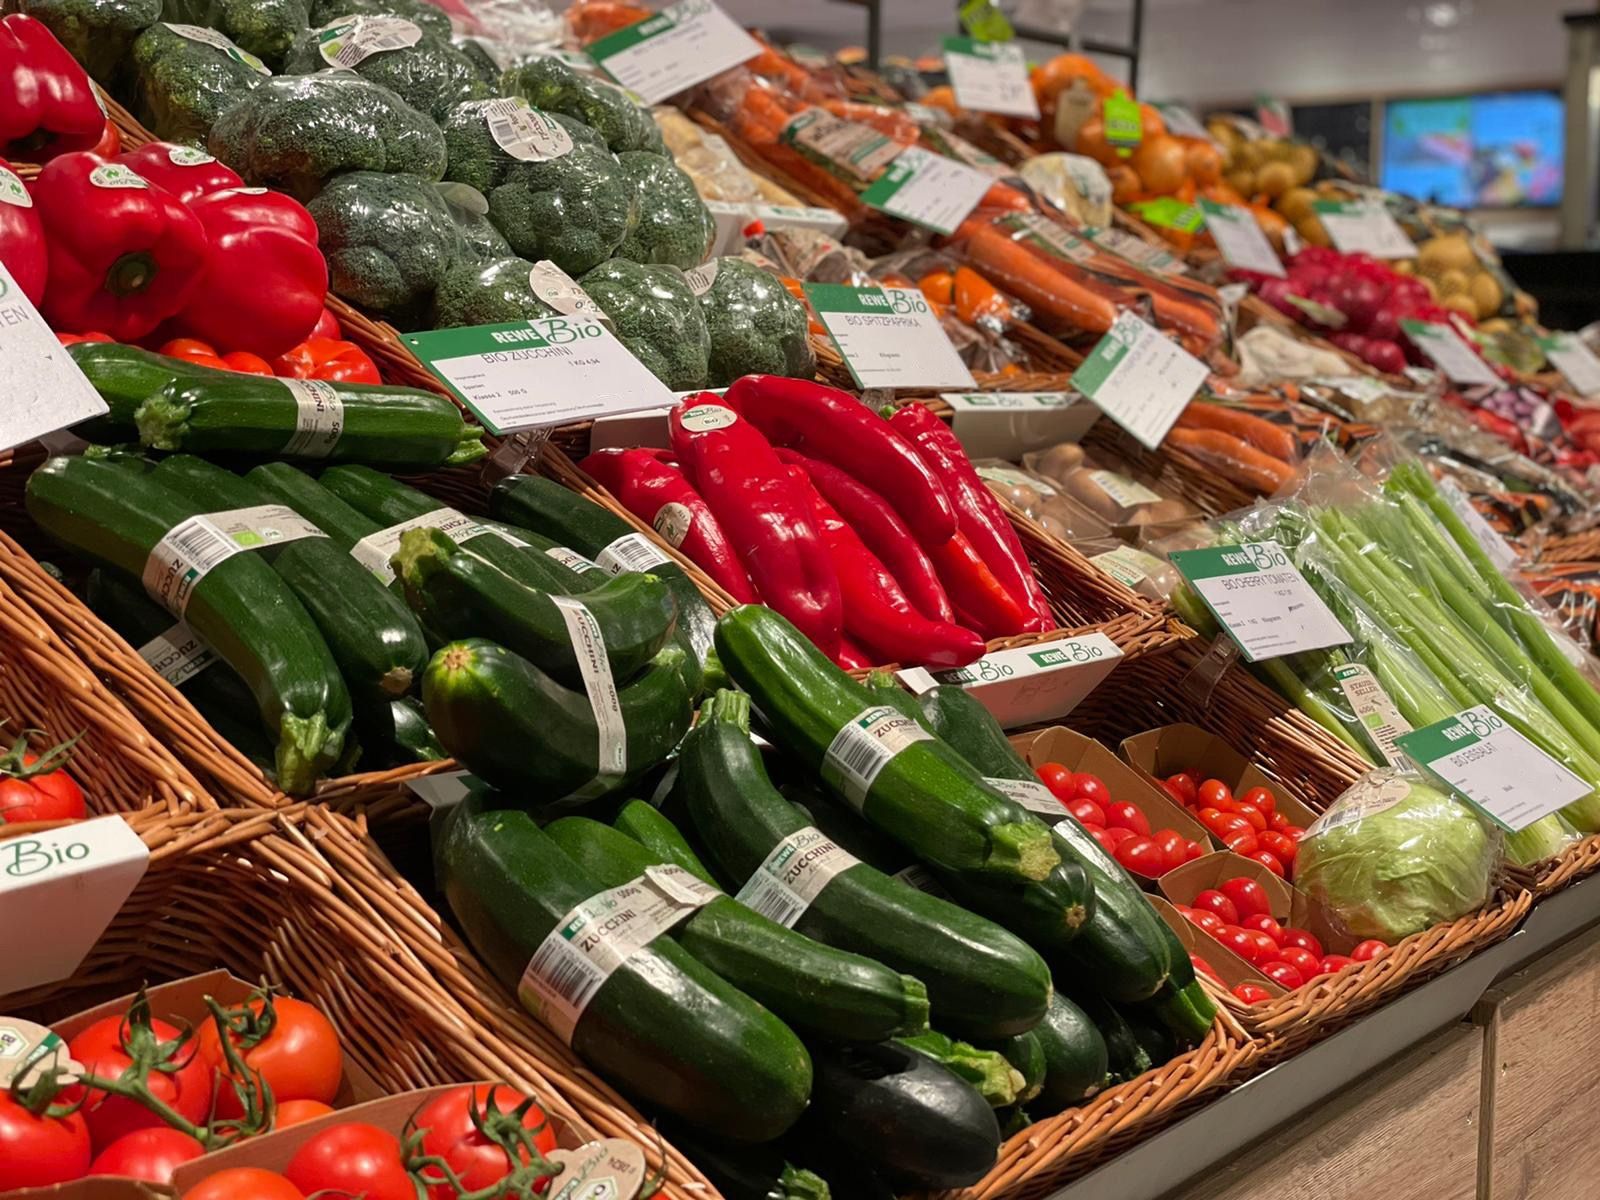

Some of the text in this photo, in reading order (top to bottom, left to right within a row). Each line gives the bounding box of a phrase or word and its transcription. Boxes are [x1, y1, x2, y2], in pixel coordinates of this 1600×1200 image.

[858, 289, 927, 314] REWE Bio
[0, 305, 30, 328] EN
[845, 315, 862, 327] BIO
[490, 318, 602, 344] REWE Bio
[481, 346, 574, 365] BIO ZUCCHINI
[1220, 544, 1287, 570] REWE Bio
[1221, 578, 1238, 590] BIO
[572, 608, 600, 674] ZUCCHINI
[943, 641, 1103, 684] REWE Bio REWE Bio
[1441, 711, 1503, 742] REWE Bio
[792, 832, 821, 849] Bio
[0, 840, 90, 877] Bio
[783, 841, 838, 886] ZUCCHINI
[578, 908, 638, 954] ZUCCHINI
